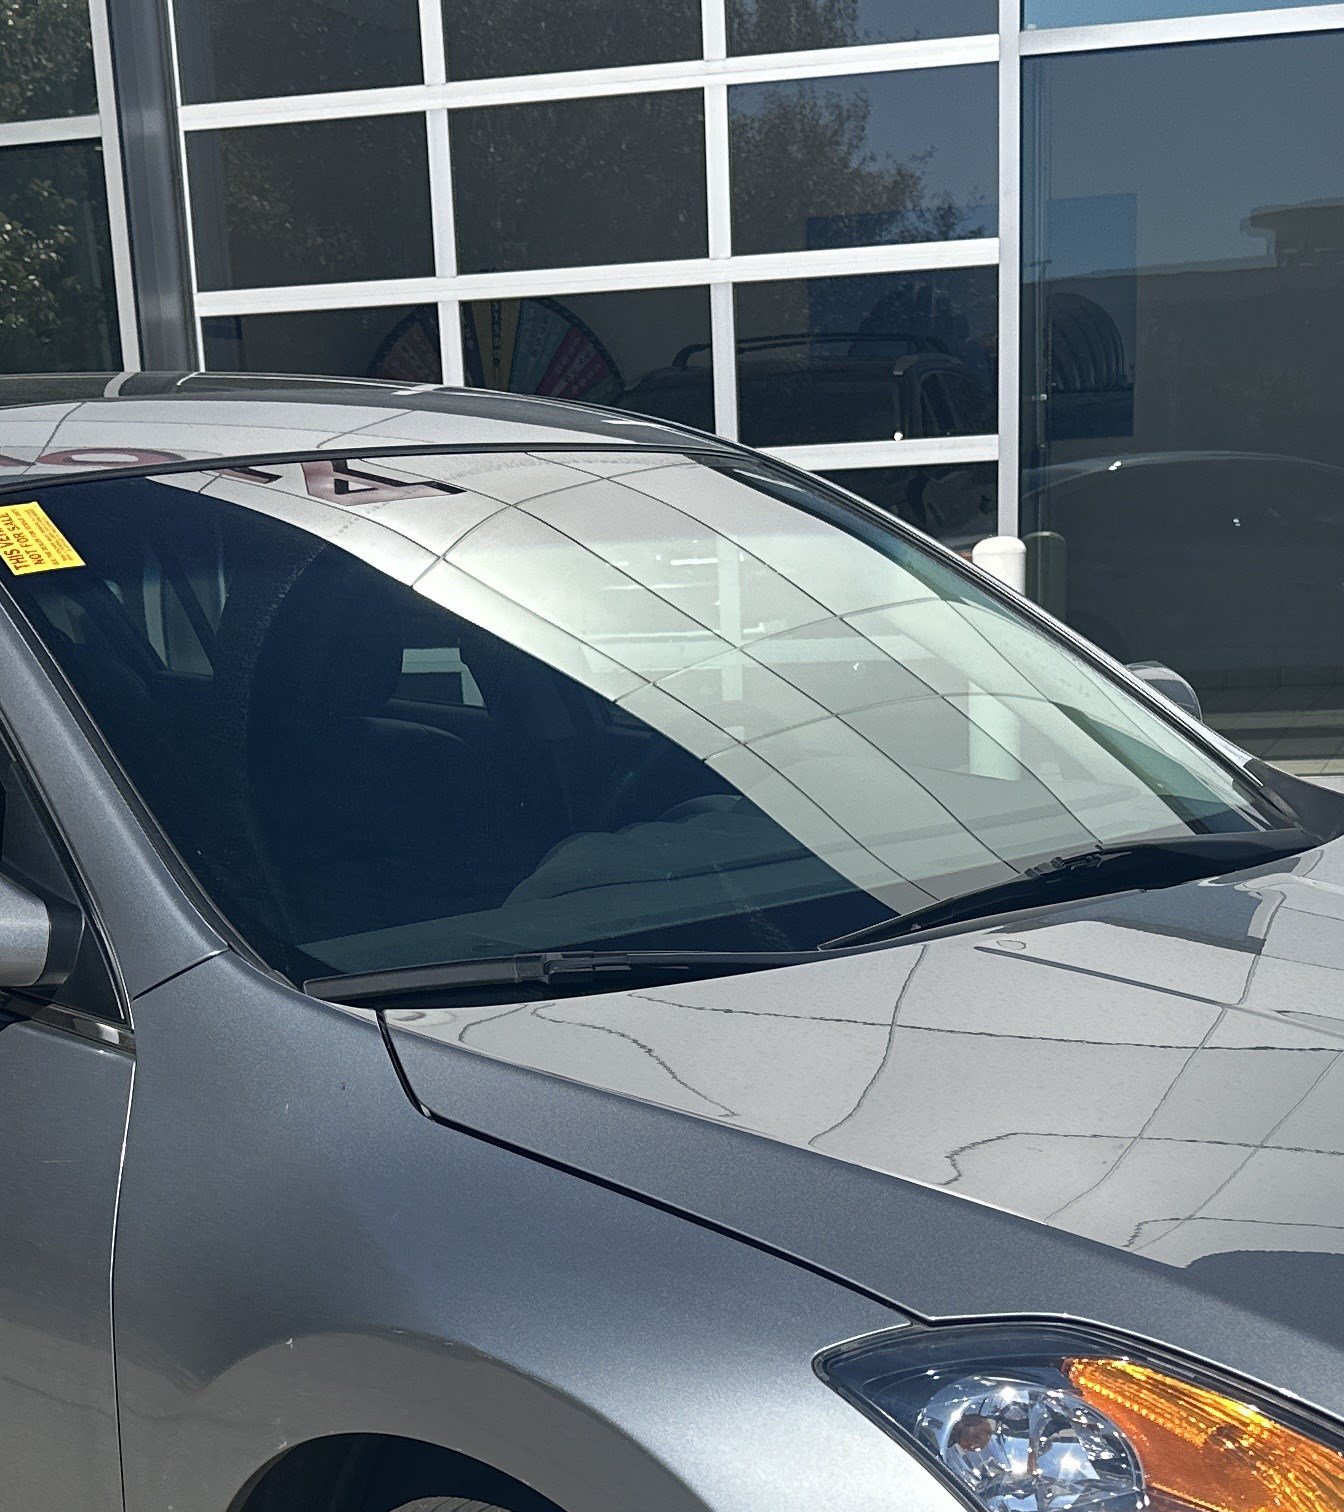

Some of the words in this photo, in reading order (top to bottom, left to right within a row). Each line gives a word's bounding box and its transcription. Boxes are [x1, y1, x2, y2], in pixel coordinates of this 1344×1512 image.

[13, 532, 31, 548] FOR
[4, 549, 30, 570] THIS
[25, 548, 45, 566] NOT
